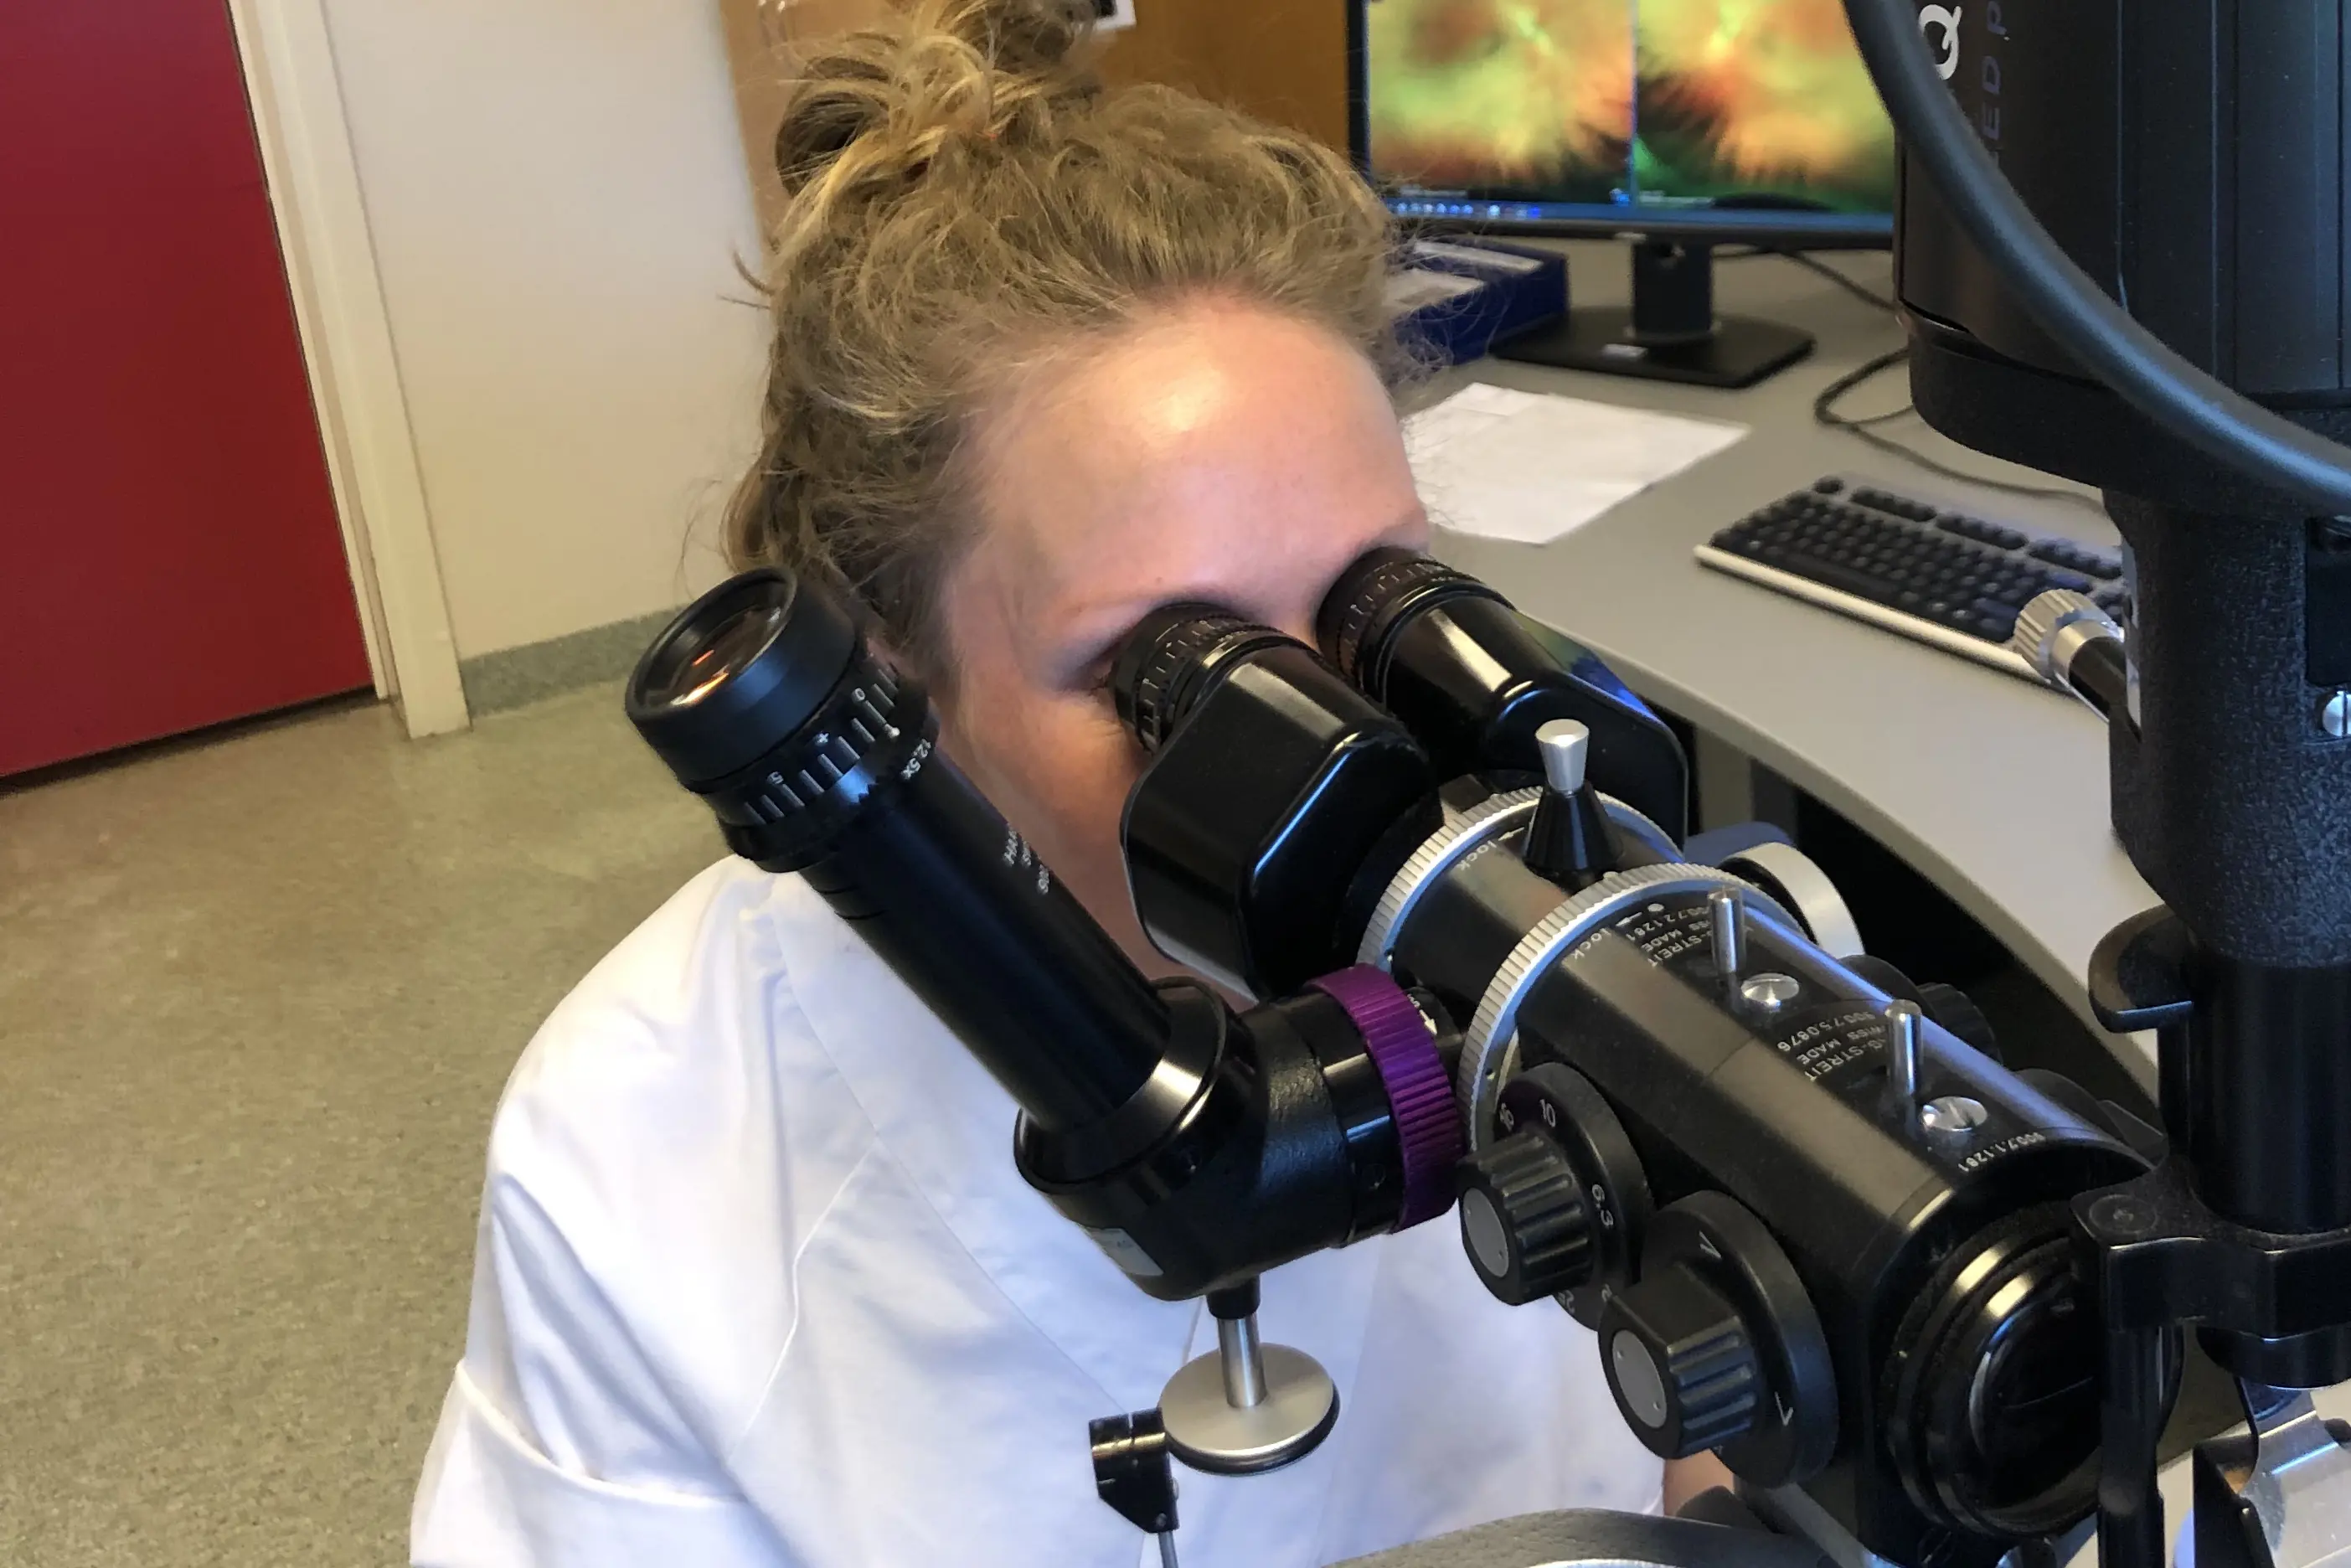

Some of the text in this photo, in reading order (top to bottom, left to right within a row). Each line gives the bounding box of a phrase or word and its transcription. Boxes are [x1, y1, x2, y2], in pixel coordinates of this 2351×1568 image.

[1641, 928, 1683, 952] MADE
[1797, 1038, 1841, 1065] MADE
[1539, 1099, 1556, 1127] 10
[1591, 1184, 1614, 1228] 6.3
